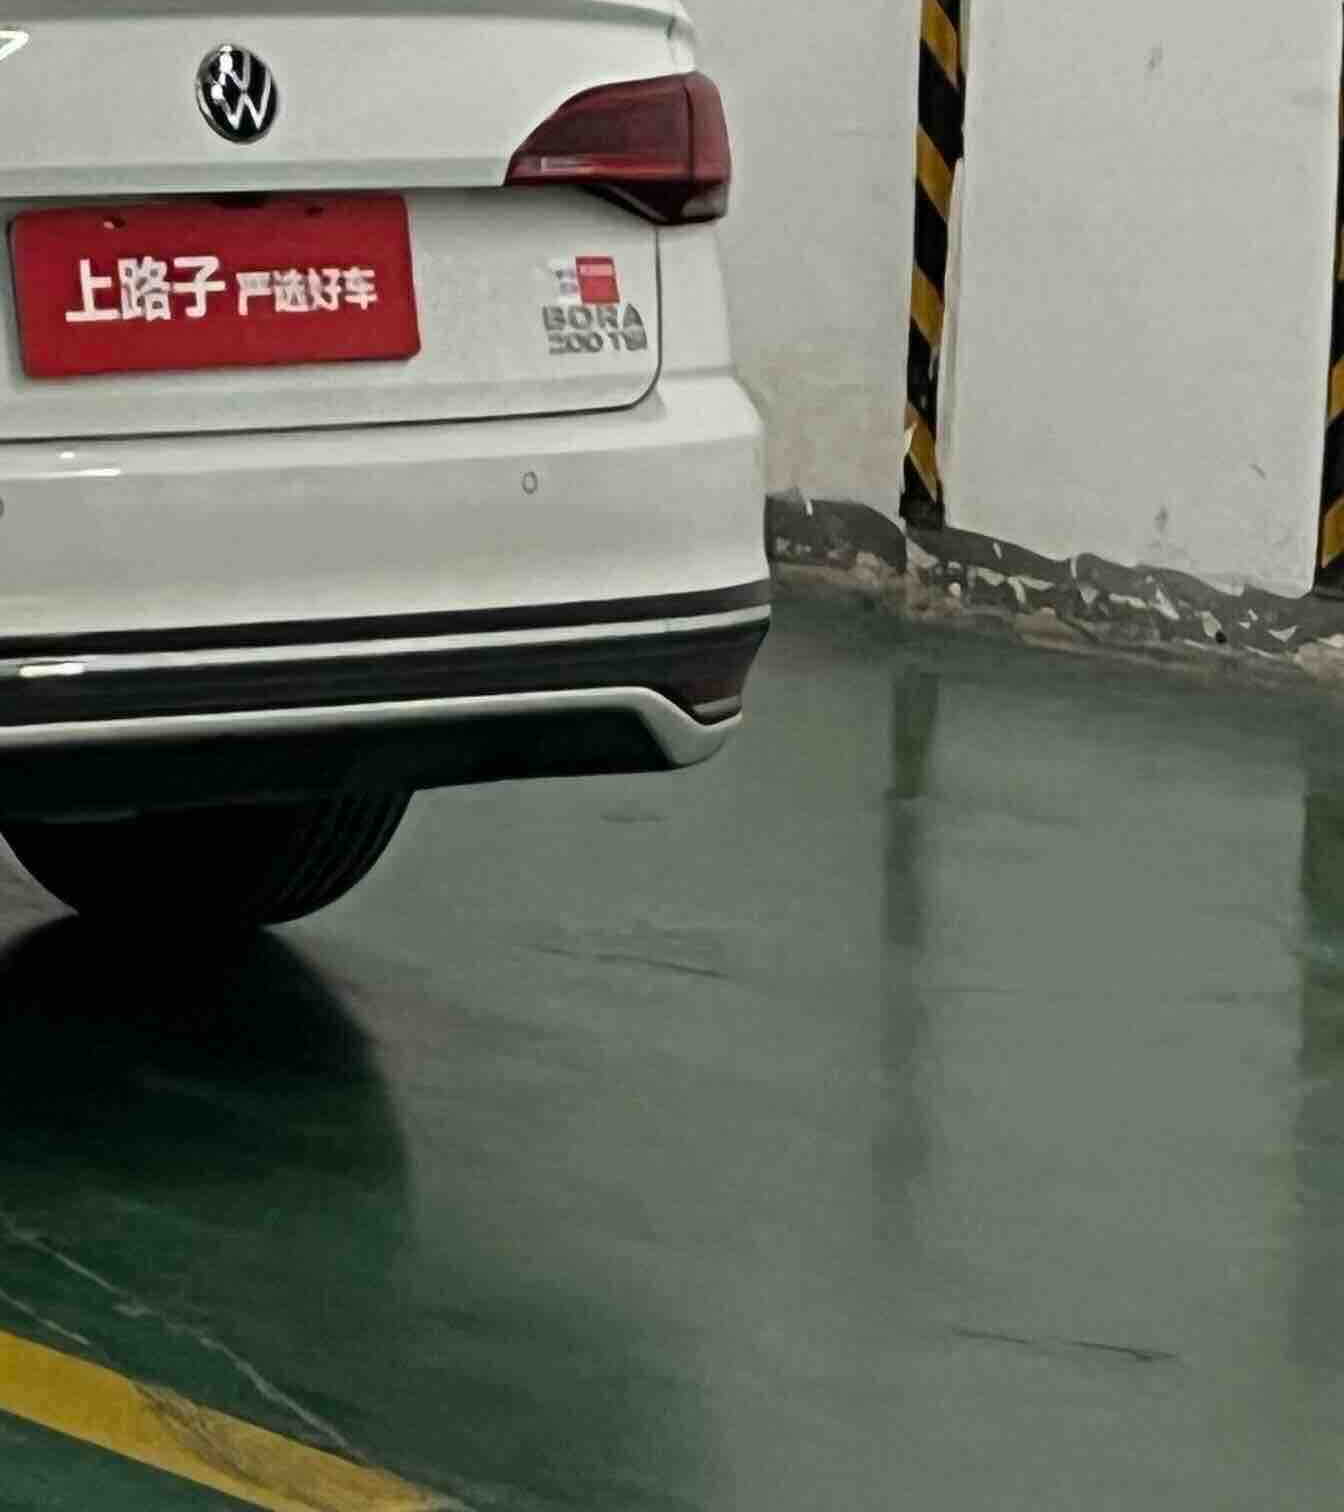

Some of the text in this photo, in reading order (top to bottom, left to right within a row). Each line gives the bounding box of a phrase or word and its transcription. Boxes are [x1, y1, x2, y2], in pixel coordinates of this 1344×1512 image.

[64, 255, 379, 323] 上路子 严选好车
